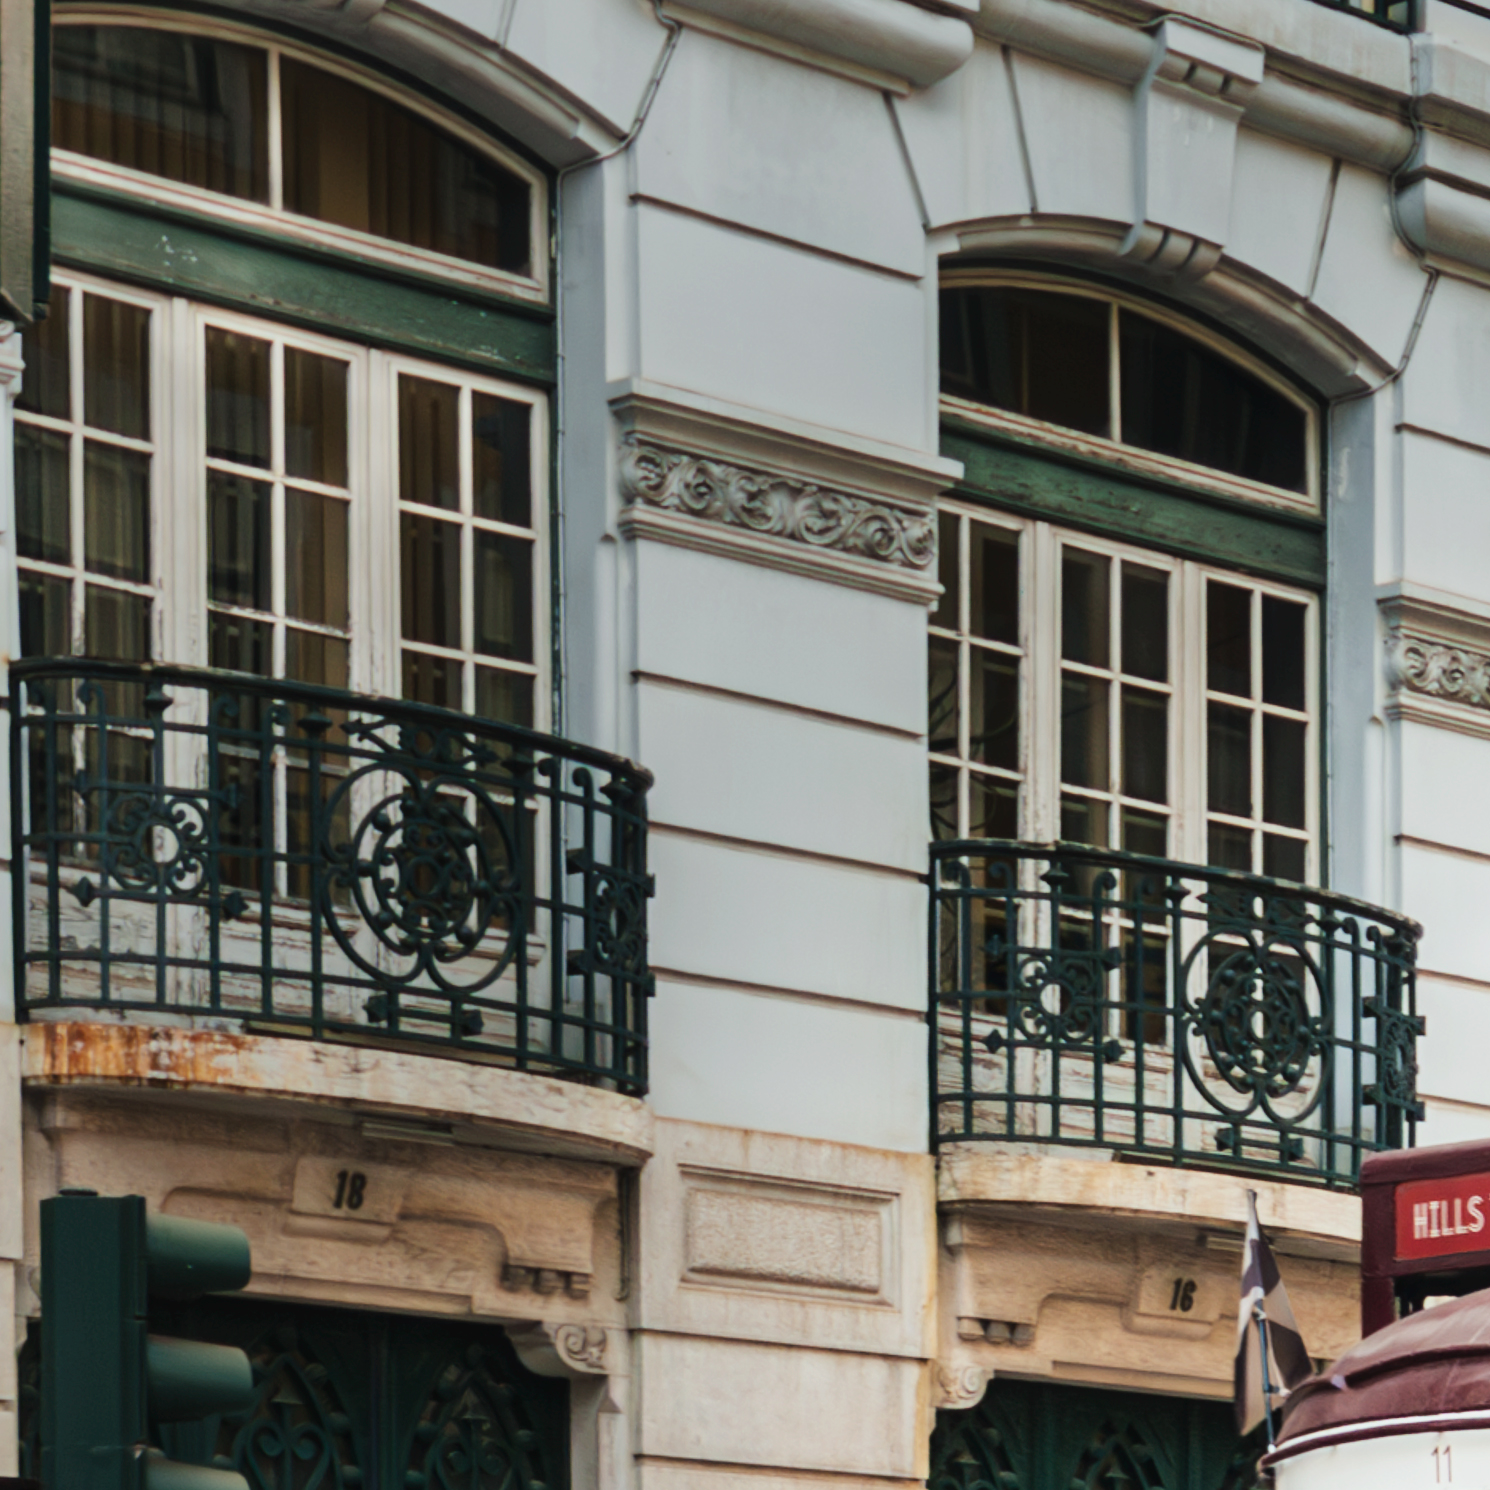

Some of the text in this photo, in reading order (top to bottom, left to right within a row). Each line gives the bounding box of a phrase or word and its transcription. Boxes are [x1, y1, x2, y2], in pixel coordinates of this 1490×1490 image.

[333, 1169, 367, 1210] 18
[1412, 1195, 1485, 1240] HILLS
[1169, 1277, 1197, 1313] 16
[1431, 1445, 1453, 1483] 11
